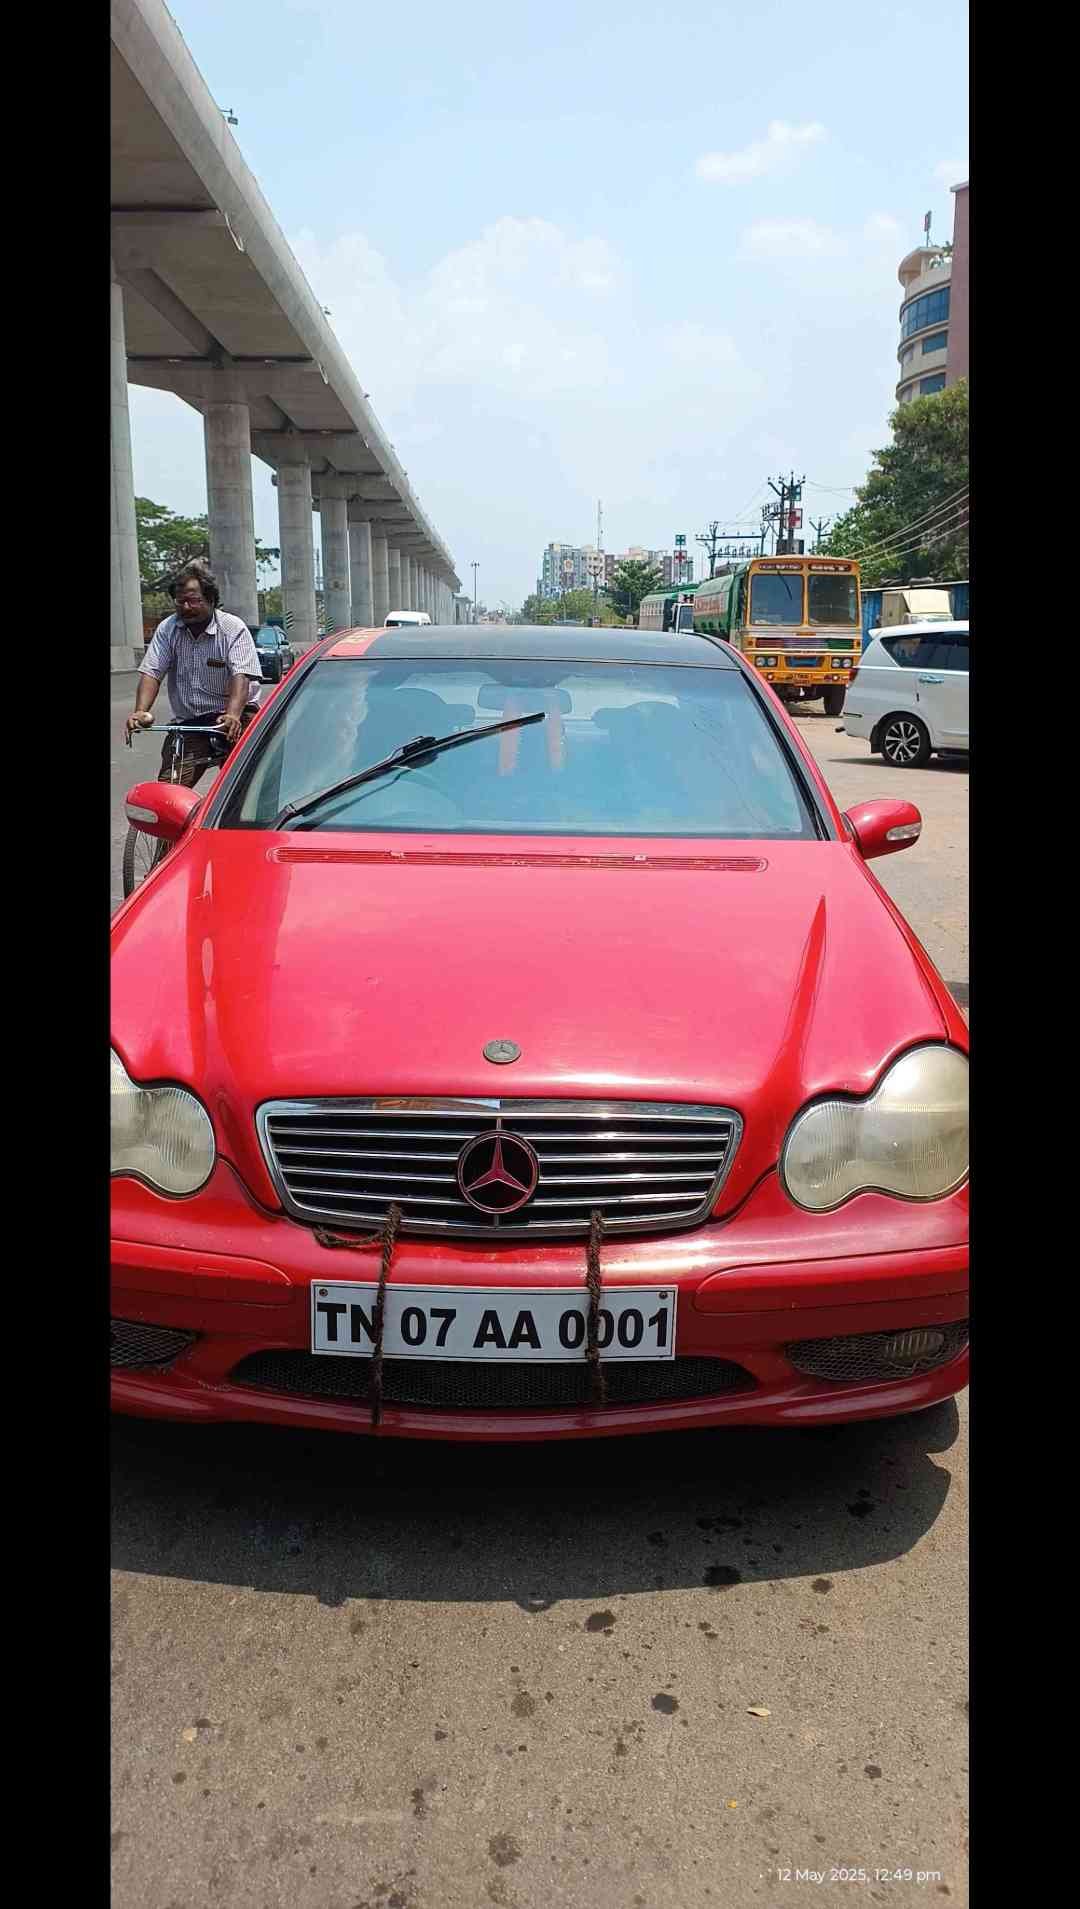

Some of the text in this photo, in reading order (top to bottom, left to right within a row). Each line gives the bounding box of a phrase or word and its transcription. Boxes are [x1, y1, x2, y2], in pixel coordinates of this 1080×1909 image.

[317, 1302, 668, 1350] TN 07 AA 0001
